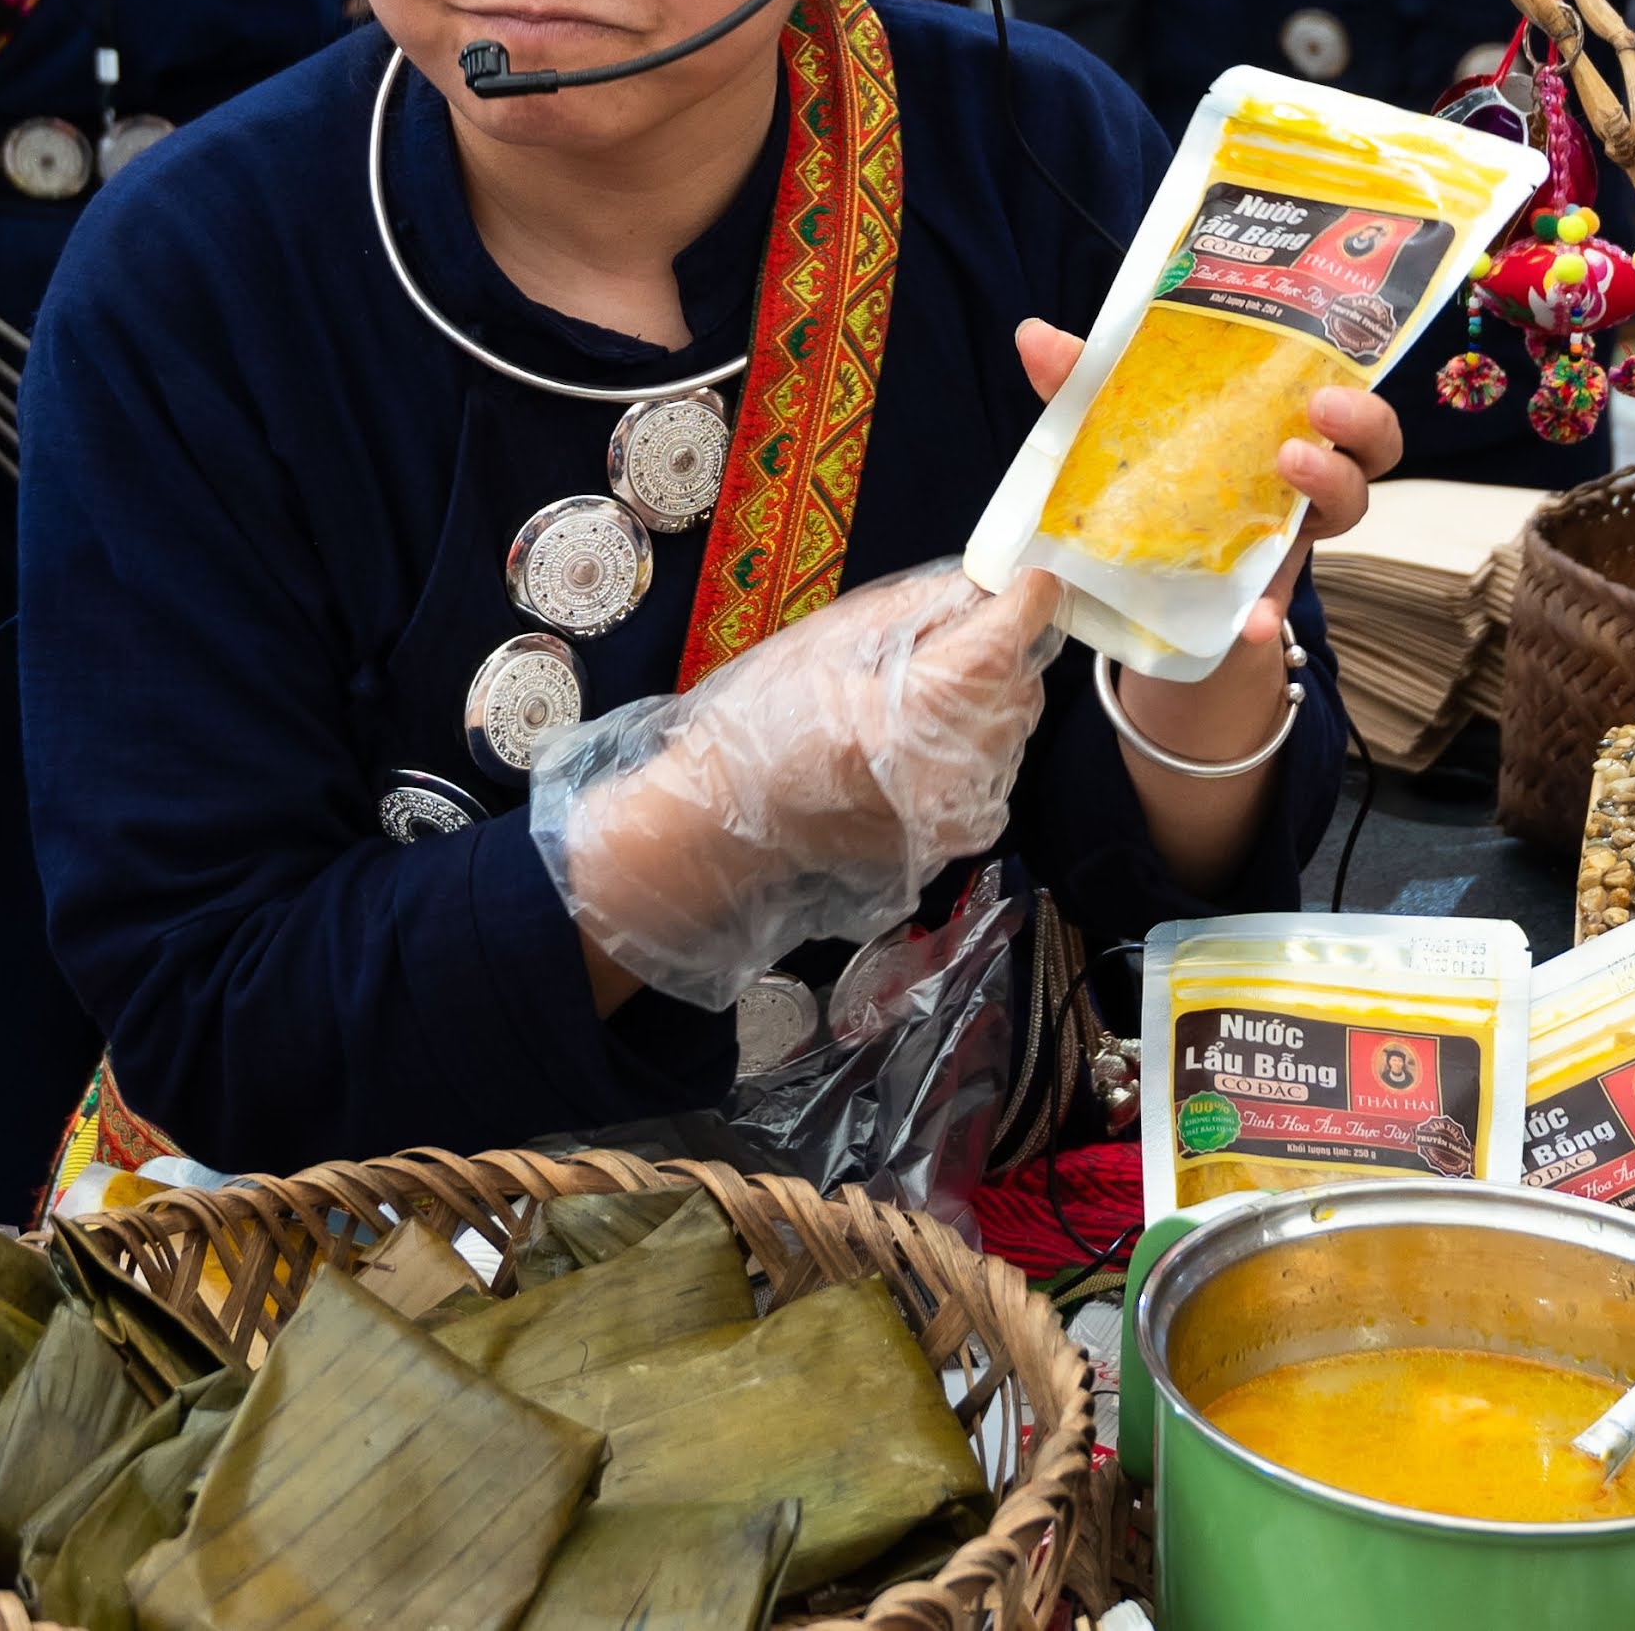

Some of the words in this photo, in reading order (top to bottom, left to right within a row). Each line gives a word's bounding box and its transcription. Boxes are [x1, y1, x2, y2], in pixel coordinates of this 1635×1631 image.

[1233, 194, 1309, 226] Nước
[1220, 1013, 1304, 1049] Nước
[1185, 1041, 1244, 1074] Lẩu
[1254, 1053, 1338, 1088] Bỗng
[1243, 1111, 1275, 1129] Tinh
[1277, 1114, 1310, 1132] Hoa
[1346, 1120, 1380, 1139] Thực
[1524, 1107, 1569, 1143] ớc
[1308, 1144, 1331, 1156] lượng
[1354, 1148, 1369, 1158] 250
[1531, 1120, 1616, 1167] Bỗng
[1581, 1179, 1613, 1199] Hoa
